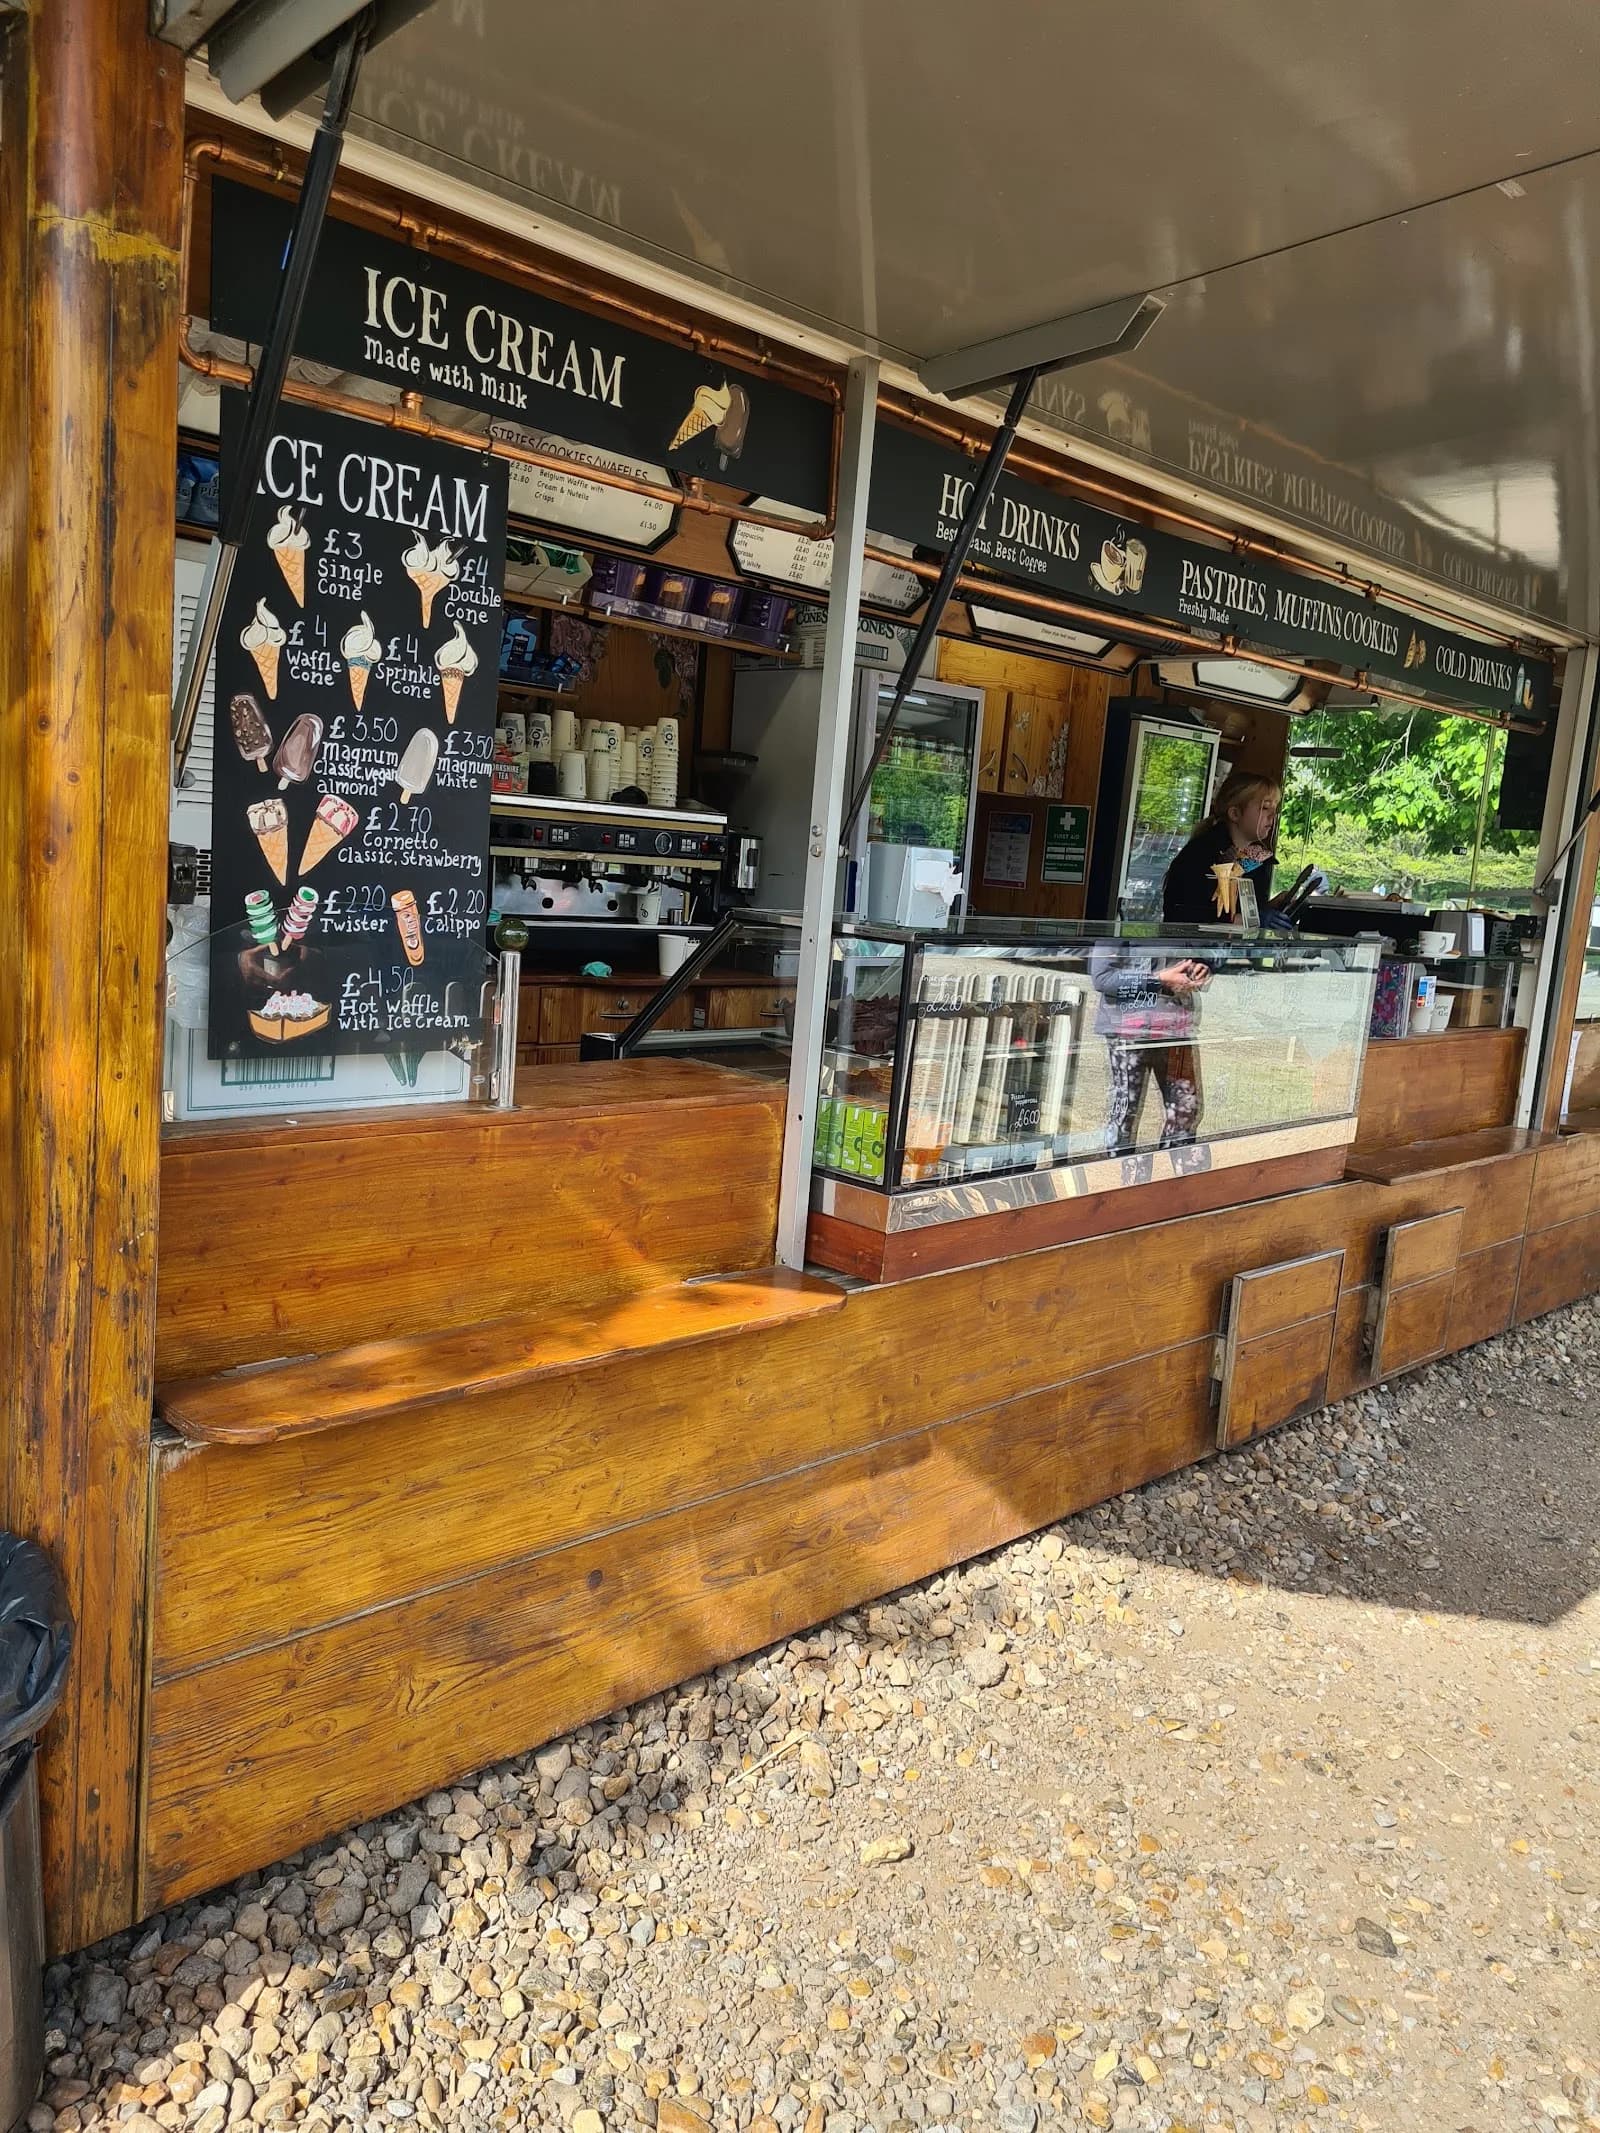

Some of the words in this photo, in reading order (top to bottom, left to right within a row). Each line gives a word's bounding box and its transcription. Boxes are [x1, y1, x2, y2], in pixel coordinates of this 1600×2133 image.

[363, 266, 449, 351] ICE
[465, 305, 626, 408] CREAM
[429, 362, 474, 393] with
[338, 453, 490, 543] CREAM
[534, 491, 555, 504] Crisps
[999, 497, 1080, 561] DRINKS
[323, 528, 363, 560] £3
[969, 536, 994, 559] eans,
[994, 541, 1017, 563] Best
[1019, 548, 1047, 574] Coffee
[317, 557, 383, 589] Single
[461, 555, 489, 586] £4
[317, 577, 363, 601] Cone
[447, 583, 502, 608] Double
[1180, 560, 1269, 622] PASTRIES,
[444, 601, 489, 625] Cone
[1178, 598, 1209, 624] Freshly
[286, 648, 342, 673] Waffle
[1435, 645, 1467, 679] COLD
[1468, 655, 1513, 691] DRINKS
[290, 666, 335, 687] Cone
[374, 662, 441, 687] Sprinkle
[391, 682, 432, 700] Cone
[443, 730, 494, 760] £3.50
[316, 778, 378, 797] almond
[435, 772, 478, 790] White
[498, 772, 509, 780] TEA
[363, 831, 439, 850] Cornetto
[338, 847, 398, 867] Classic,
[426, 888, 486, 915] £2.20
[319, 914, 389, 933] Twister
[424, 912, 481, 939] Calippo
[342, 966, 414, 998] £4.50
[339, 995, 379, 1016] Hot
[386, 1014, 412, 1031] Ice
